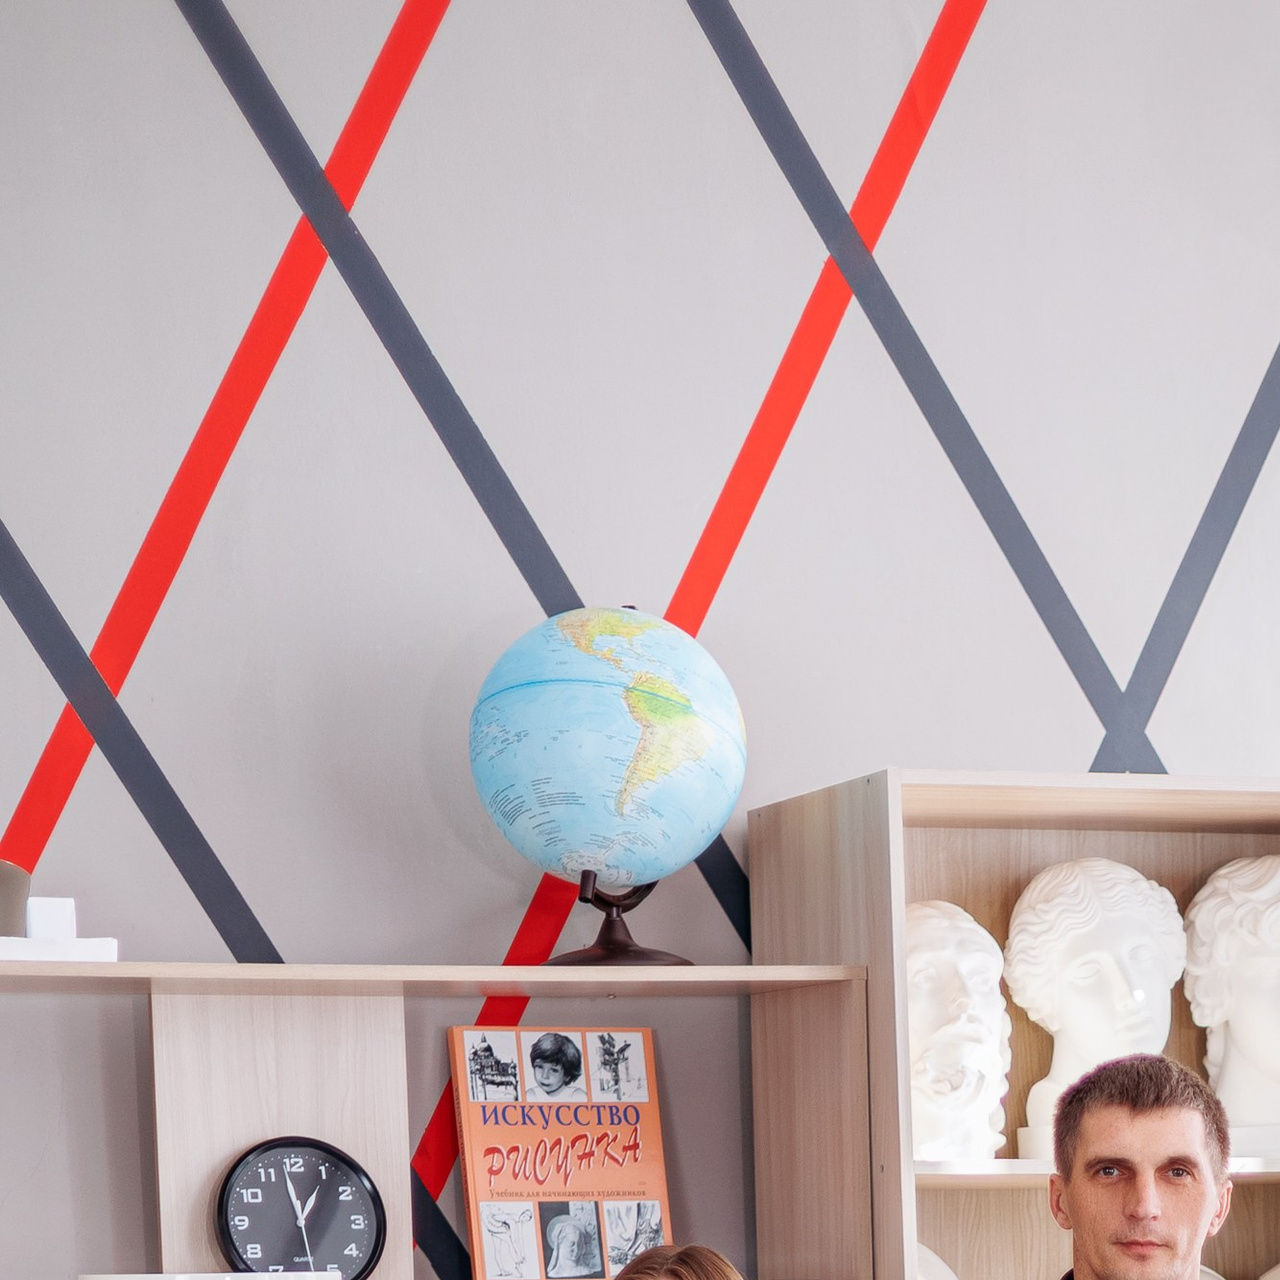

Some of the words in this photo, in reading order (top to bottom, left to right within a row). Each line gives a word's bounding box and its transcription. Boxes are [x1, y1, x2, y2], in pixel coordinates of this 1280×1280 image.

[480, 1104, 640, 1130] ИСКУССТВО
[483, 1125, 643, 1187] РИСУНКА
[283, 1158, 304, 1172] 12
[319, 1165, 326, 1179] 1
[258, 1168, 276, 1182] 11
[240, 1188, 262, 1203] 10
[338, 1186, 352, 1200] 2
[489, 1189, 525, 1199] Учебник
[526, 1190, 540, 1198] для
[234, 1216, 249, 1230] 9
[350, 1215, 364, 1229] 3
[247, 1244, 262, 1258] 8
[344, 1243, 359, 1257] 4
